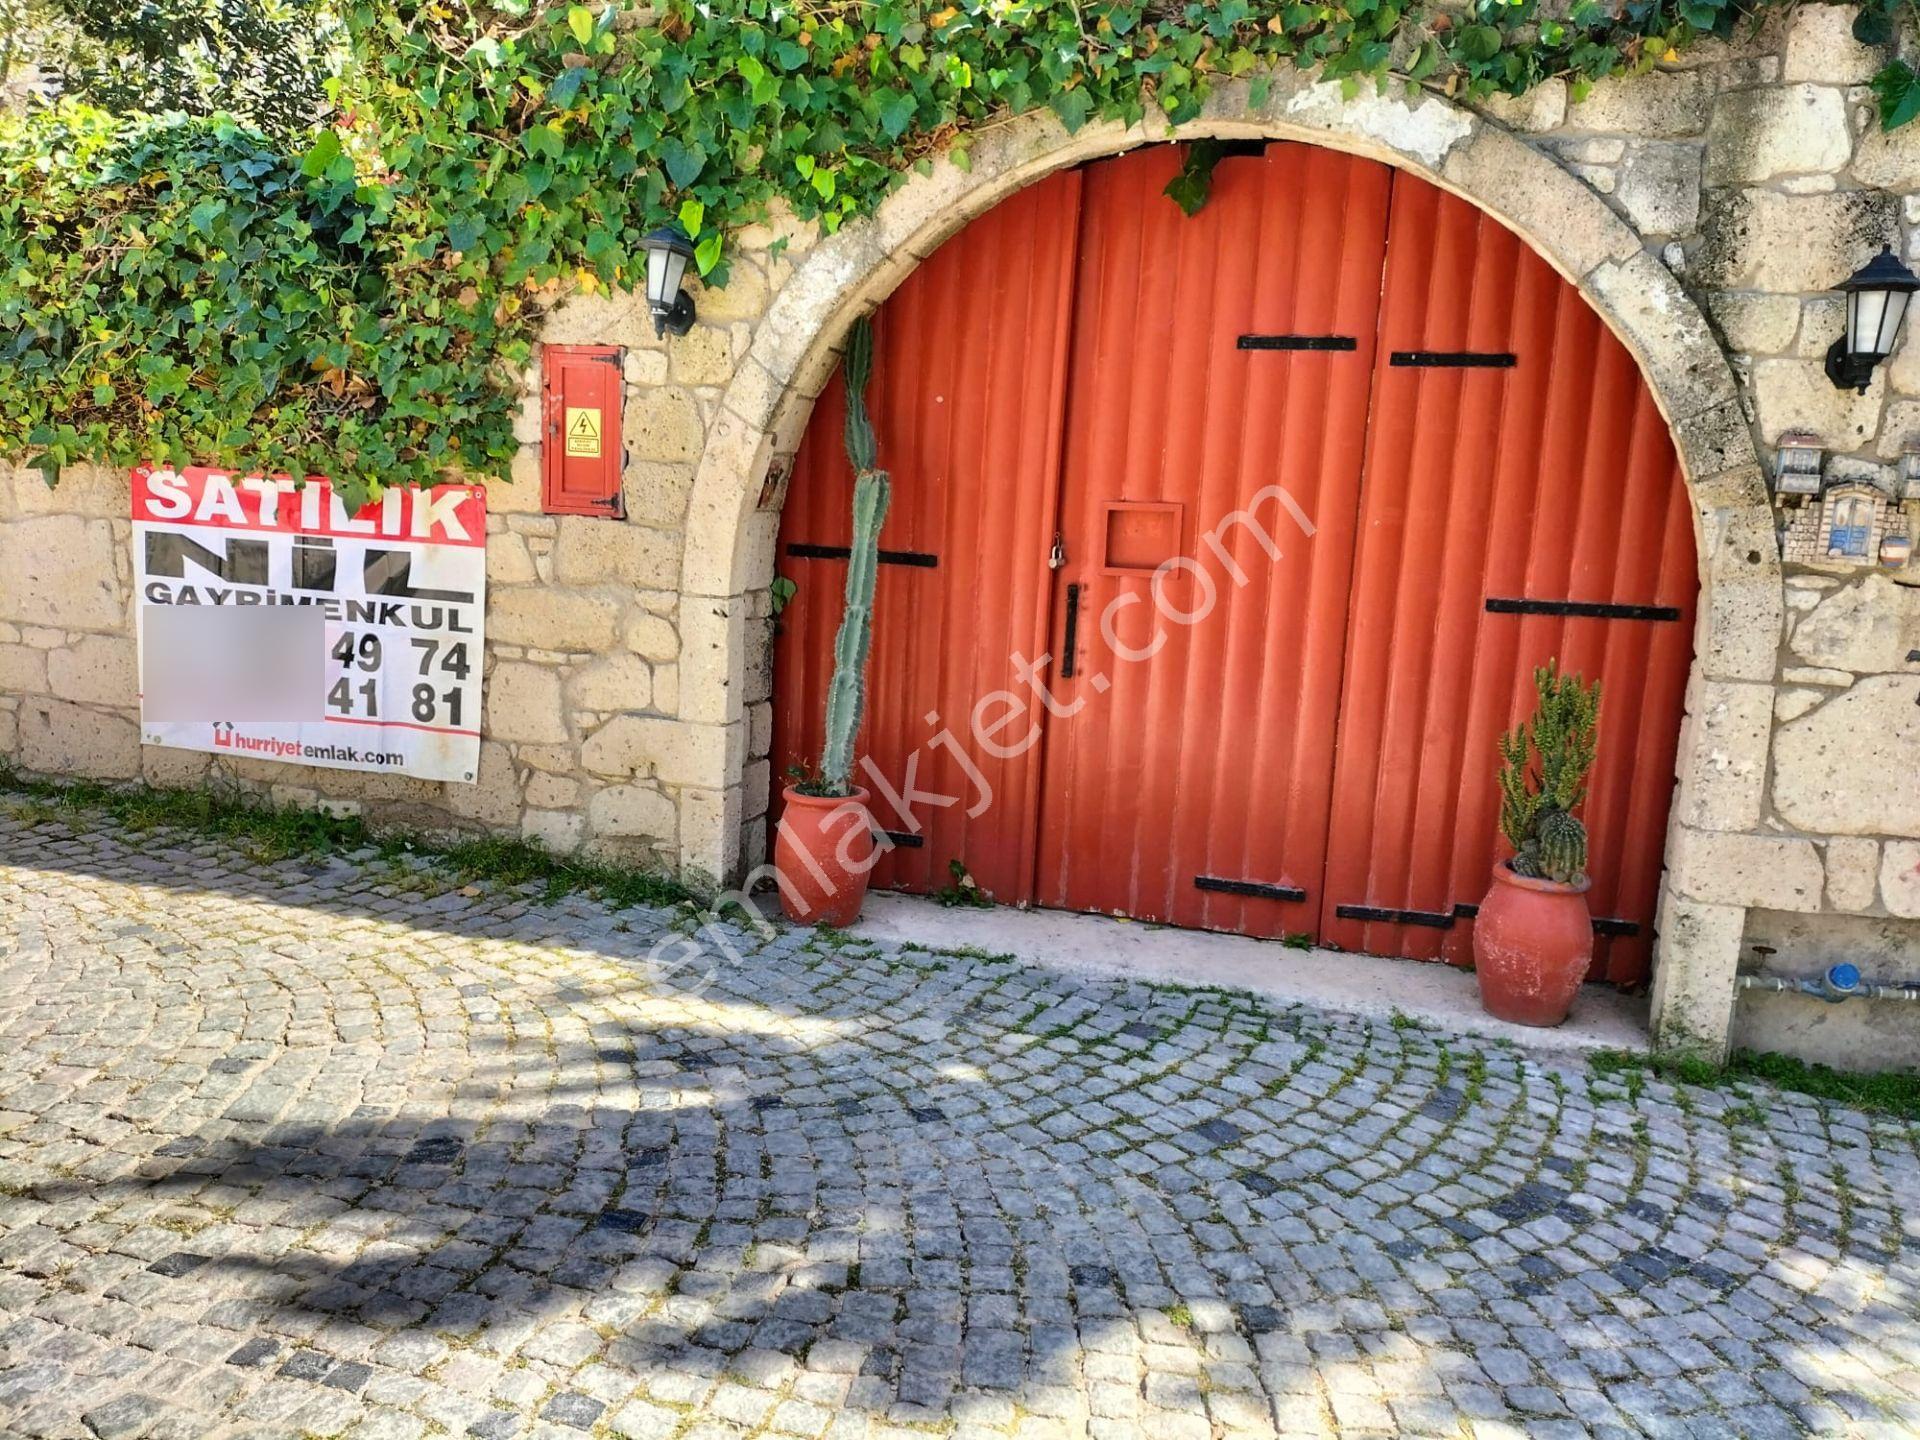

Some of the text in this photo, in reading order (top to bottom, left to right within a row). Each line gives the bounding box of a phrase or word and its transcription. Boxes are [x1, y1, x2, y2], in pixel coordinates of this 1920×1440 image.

[144, 470, 472, 541] SATILIK
[331, 631, 471, 680] 49 74
[327, 677, 462, 726] 41 81
[235, 733, 404, 765] hurriyetemlak.com
